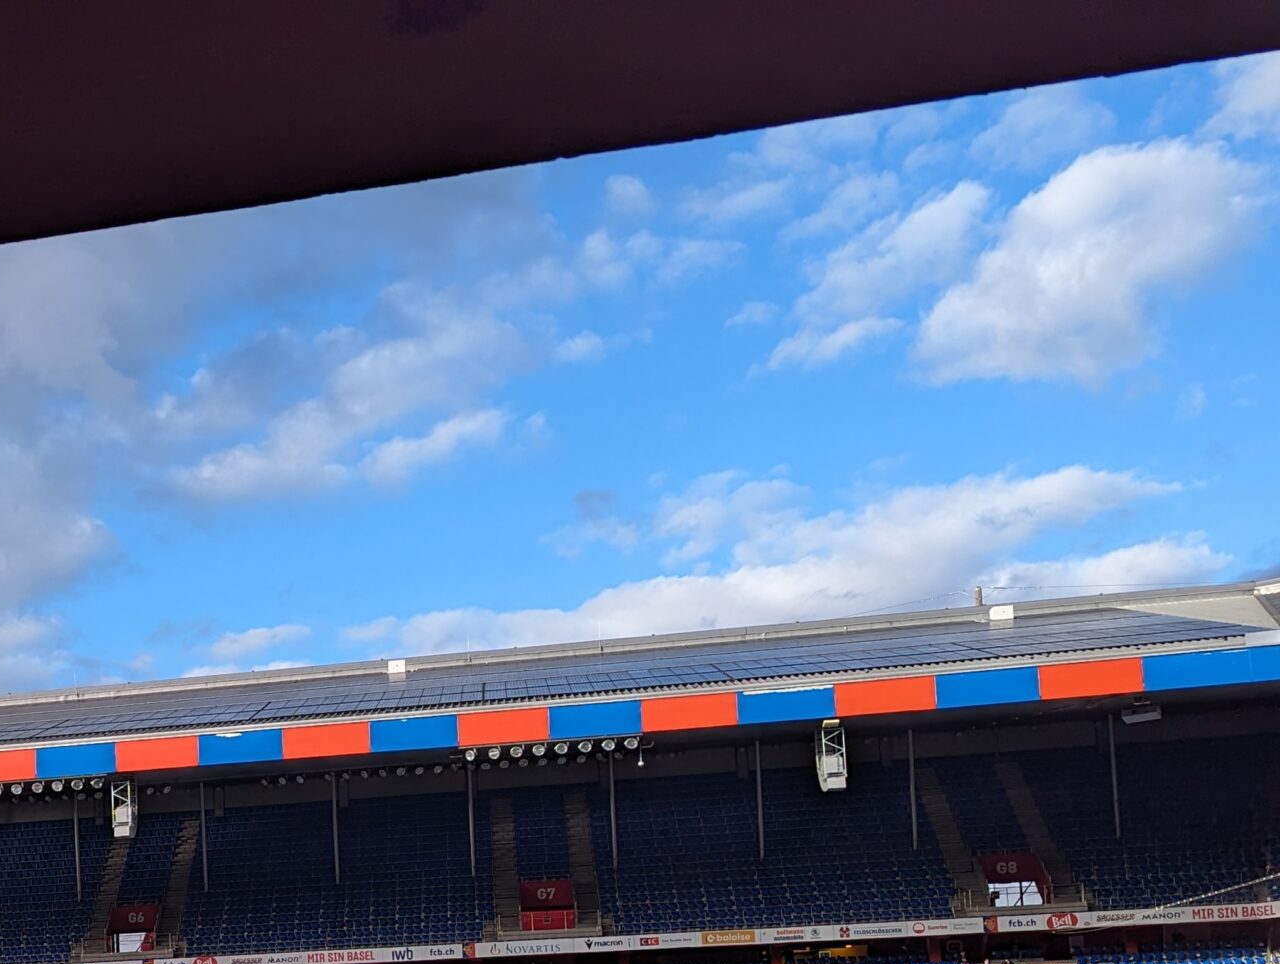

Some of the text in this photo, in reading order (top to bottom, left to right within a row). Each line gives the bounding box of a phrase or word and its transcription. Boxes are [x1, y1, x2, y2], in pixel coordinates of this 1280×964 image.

[996, 861, 1018, 874] G8
[536, 888, 556, 900] G7
[1141, 910, 1181, 920] MANOR
[1192, 904, 1276, 920] MIR SIN BASEL
[127, 912, 145, 924] G6
[1008, 918, 1037, 929] fcb.ch
[1051, 913, 1072, 926] Bell
[641, 937, 658, 945] CIC
[716, 930, 751, 941] baloise
[506, 943, 561, 954] NOVARTIS
[594, 938, 623, 948] macron
[307, 951, 375, 963] MIR SIN BASEL
[429, 947, 455, 957] fcb.ch
